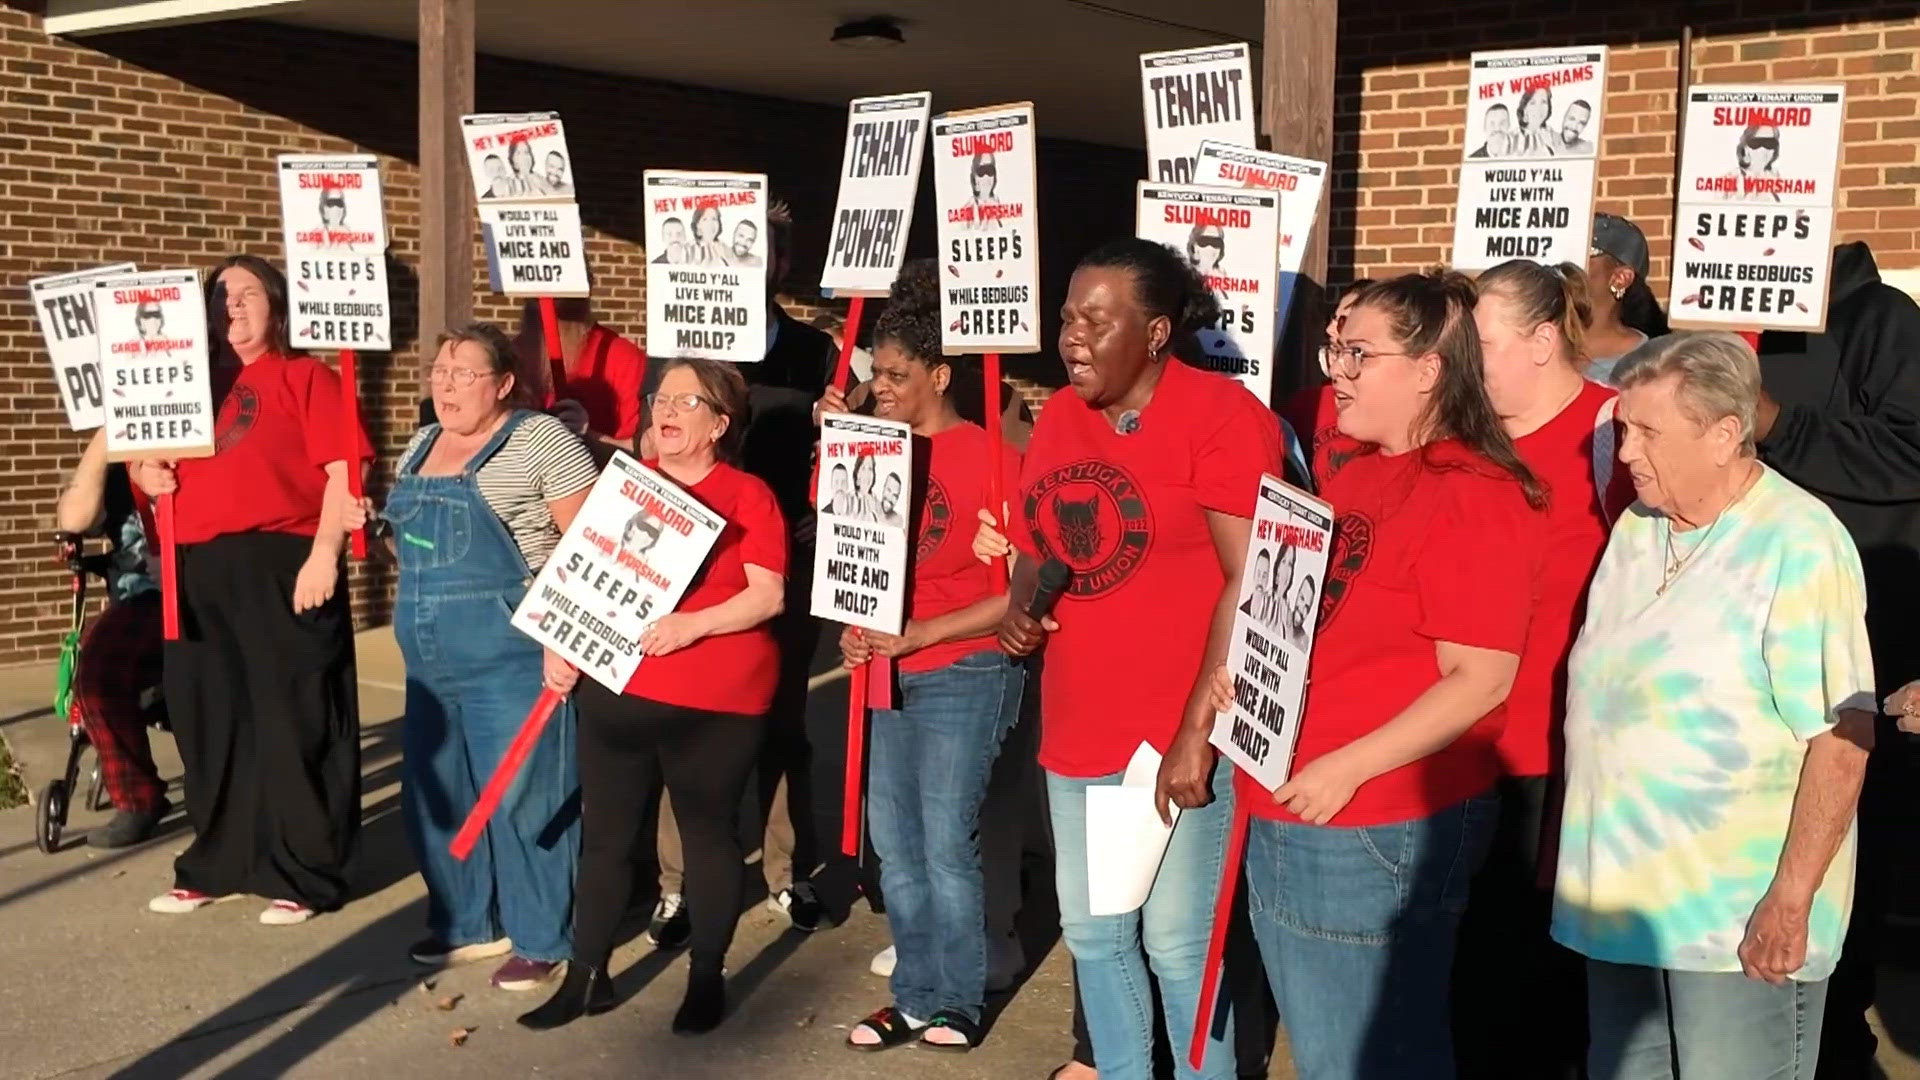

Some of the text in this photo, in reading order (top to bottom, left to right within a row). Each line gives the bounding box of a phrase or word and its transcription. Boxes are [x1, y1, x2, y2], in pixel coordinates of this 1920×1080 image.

[1487, 58, 1528, 67] KENTUCKY
[1530, 56, 1560, 65] TENANT
[1479, 65, 1593, 99] HEY WORSHAMS
[1150, 69, 1242, 129] TENANT
[1707, 93, 1824, 102] KENTUCKY TENANT UNION
[1713, 107, 1811, 126] SLUMLORD
[473, 123, 558, 151] HEY WORSHAMS
[952, 131, 1013, 158] SLUMLORD
[849, 119, 919, 178] TENANT
[299, 173, 362, 189] SLUMLORD
[1218, 163, 1298, 191] SLUMLORD
[1486, 169, 1563, 182] WOULD Y'ALL
[1696, 177, 1815, 194] CAROL WORSHAM
[654, 191, 756, 214] HEY WORSHAMS
[1158, 192, 1260, 205] KENTUCKY TENANT UNION
[1490, 188, 1554, 201] LIVE WITH
[498, 211, 558, 222] WOULD Y'ALL
[948, 204, 1023, 223] CAROL WORSHAM
[1164, 204, 1251, 228] SLUMLORD
[1475, 207, 1569, 228] MICE AND
[506, 226, 555, 236] LIVE WITH
[1697, 213, 1810, 239] SLEEPS
[296, 232, 375, 243] CAROL WORSHAM
[831, 209, 903, 268] POWER!
[952, 235, 1021, 262] SLEEPS
[1486, 236, 1553, 257] MOLD?
[498, 241, 570, 258] MICE AND
[301, 261, 375, 280] SLEEPS
[513, 265, 562, 282] MOLD?
[669, 271, 739, 286] WOULD Y'ALL
[1685, 261, 1813, 284] WHILE BEDBUGS
[1202, 274, 1259, 293] ORSHAM
[113, 288, 181, 304] SLUMLORD
[675, 288, 733, 302] LIVE WITH
[949, 286, 1029, 305] WHILE BEDBUGS
[1698, 285, 1795, 314] CREEP
[43, 291, 97, 341] TEN
[299, 301, 383, 316] WHILE BEDBUGS
[664, 304, 748, 326] MICE AND
[310, 321, 373, 341] CREEP
[960, 309, 1019, 335] CREEP
[111, 338, 193, 354] CAROL WORSHAM
[676, 330, 735, 350] MOLD?
[116, 365, 193, 385] SLEEPS
[1209, 354, 1260, 376] DBUGS
[114, 402, 201, 418] WHILE BEDBUGS
[126, 419, 192, 440] CREEP
[828, 441, 902, 458] HEY WORSHAMS
[1031, 464, 1139, 499] KENTUCKY
[620, 480, 695, 536] SLUMLORD
[834, 523, 885, 545] WOULD Y'ALL
[1256, 519, 1324, 553] HEY WORSHAMS
[583, 526, 672, 592] CAROL WORSHAM
[837, 542, 880, 563] LIVE WITH
[828, 559, 889, 591] MICE AND
[1090, 544, 1139, 590] UNION
[567, 552, 653, 620] SLEEPS
[834, 589, 877, 617] MOLD?
[541, 585, 636, 657] WHILE BEDBUGS
[538, 610, 616, 669] CREEP
[1245, 627, 1289, 672] WOULD Y'ALL
[1244, 653, 1281, 693] LIVE WITH
[1234, 674, 1285, 737] MICE AND
[1231, 715, 1270, 766] MOLD?
